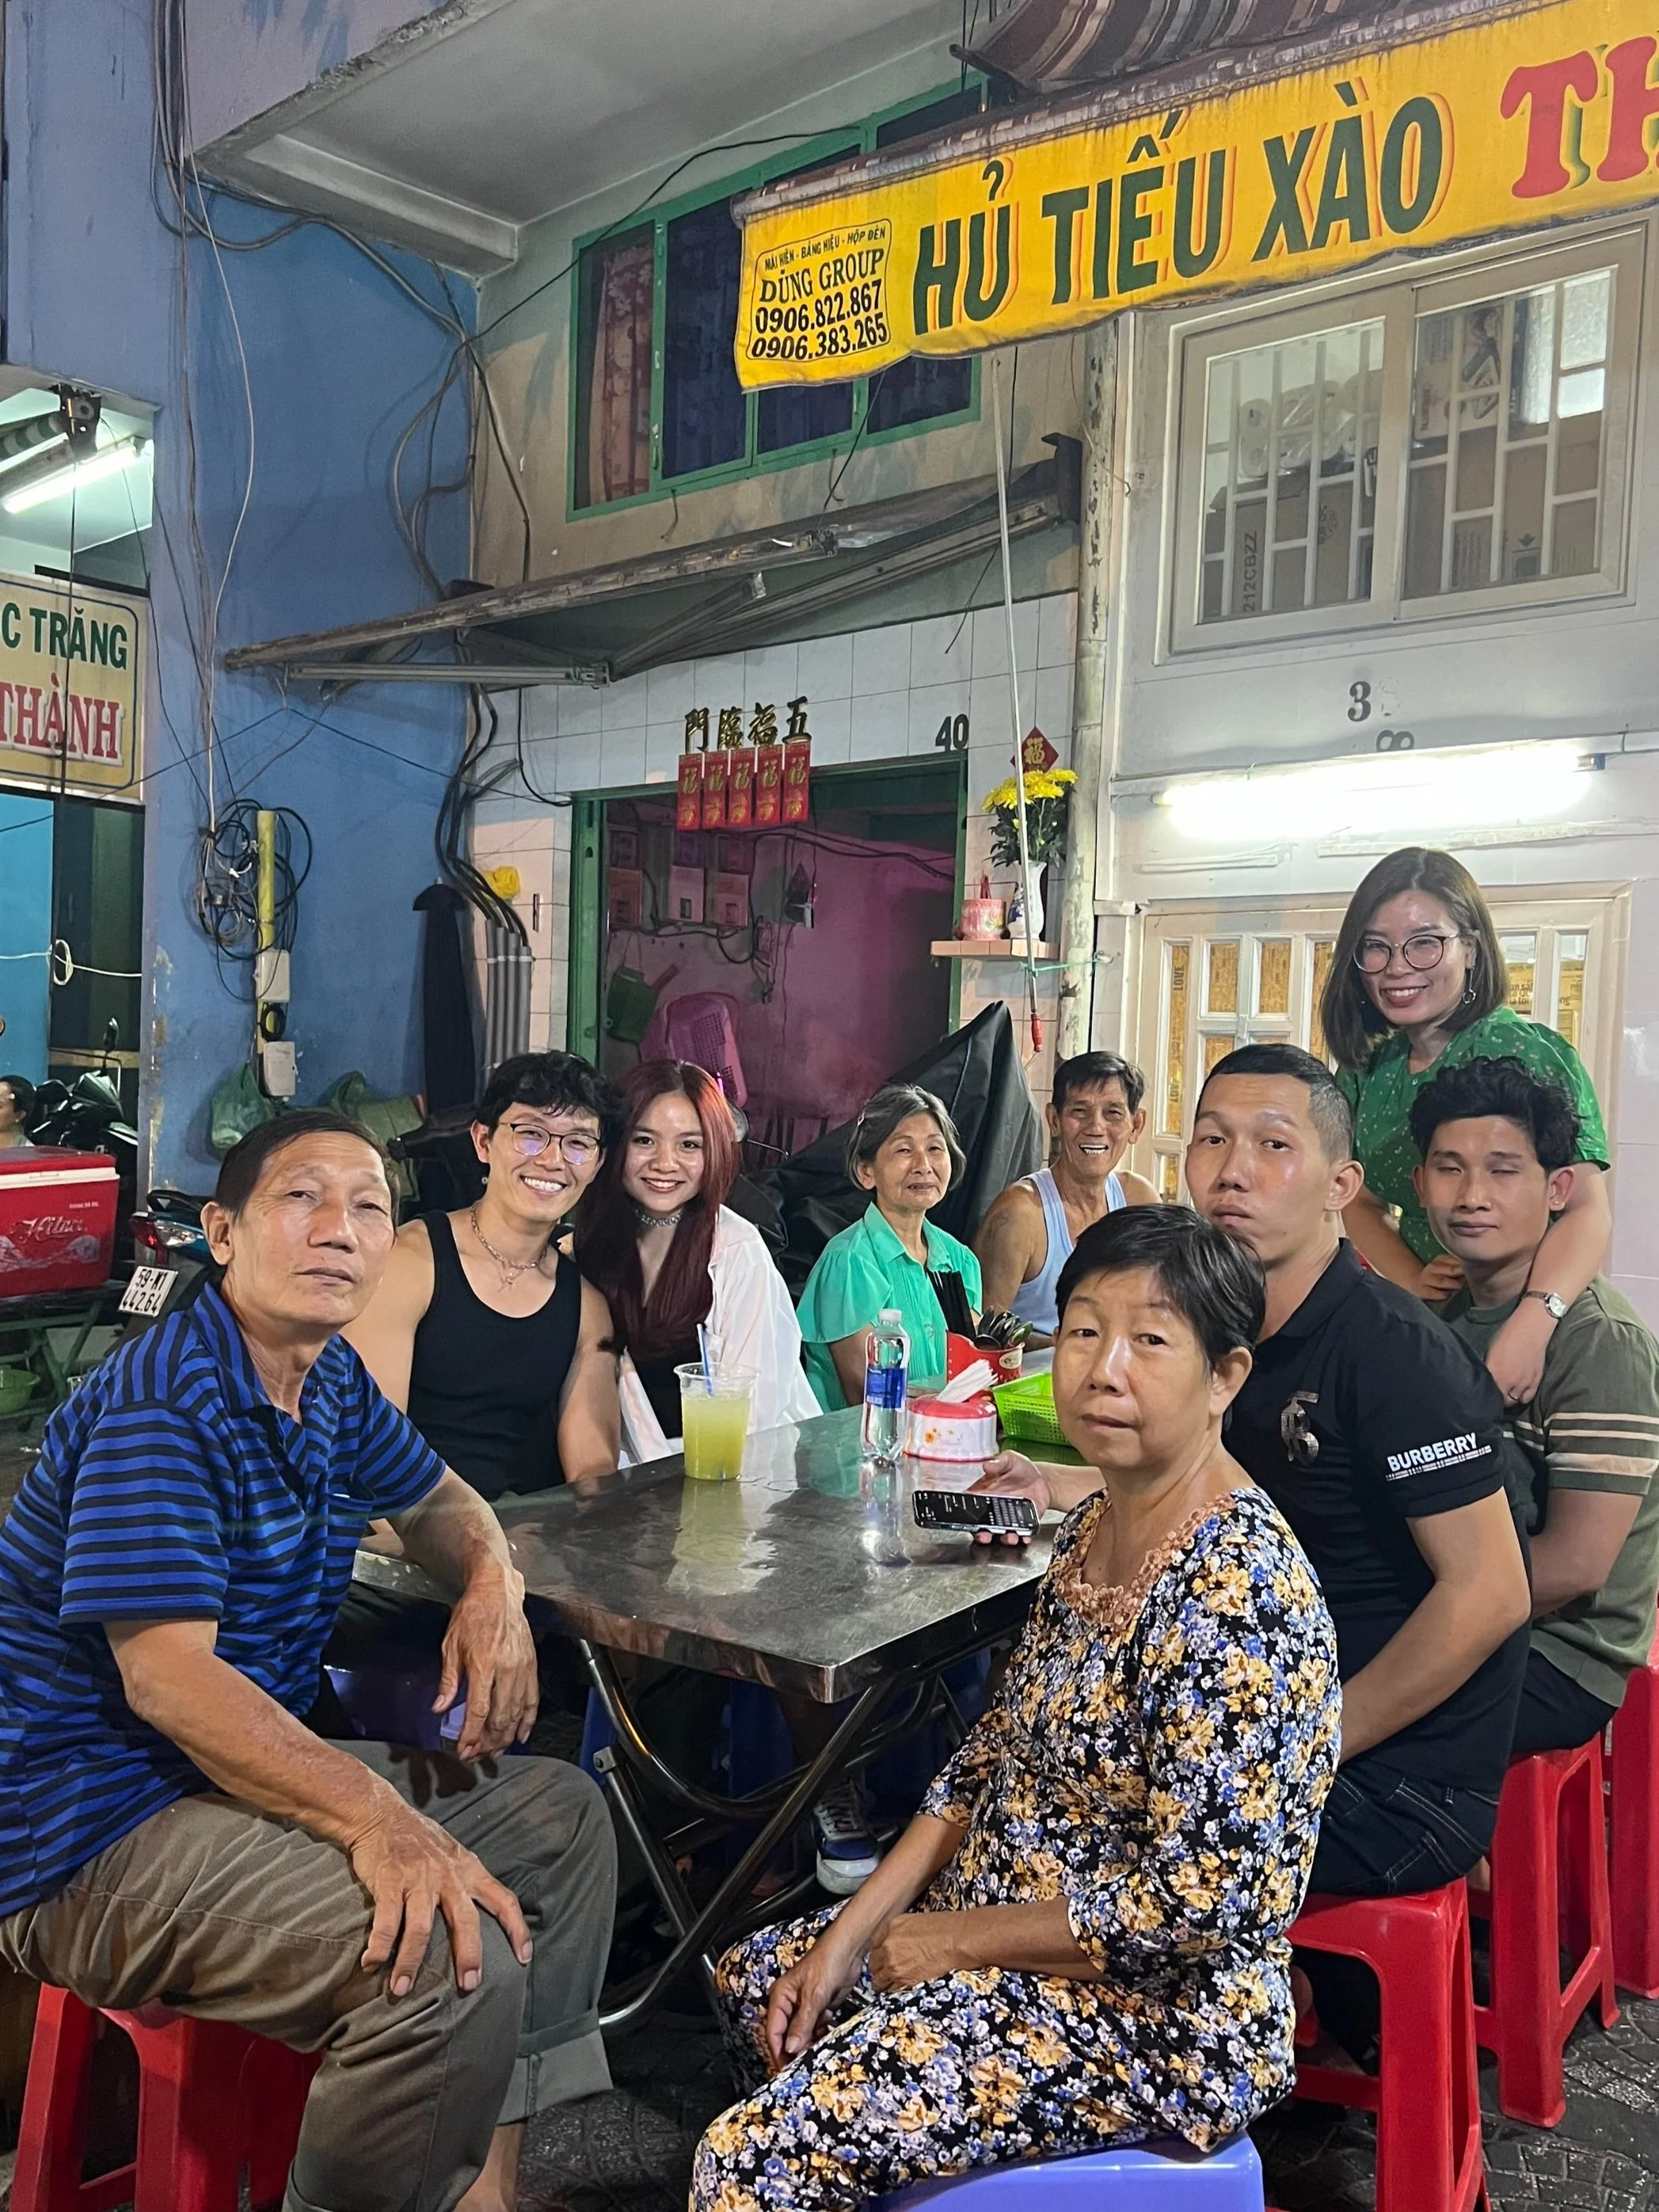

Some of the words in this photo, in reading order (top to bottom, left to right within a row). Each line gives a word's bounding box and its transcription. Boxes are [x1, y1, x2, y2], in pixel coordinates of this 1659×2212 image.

[913, 158, 1015, 335] HỦ
[1042, 109, 1227, 306] TIẾU
[1251, 81, 1444, 263] XÀO
[819, 247, 885, 291] GROUP
[755, 278, 883, 334] 0906.822.867
[751, 312, 888, 360] 0906.383.265
[29, 606, 128, 671] TRĂNG
[934, 713, 970, 753] 40
[1023, 736, 1047, 766] 福
[1173, 965, 1185, 991] LOVE
[122, 1289, 162, 1314] 442.64
[1387, 1431, 1478, 1473] BURBERRY
